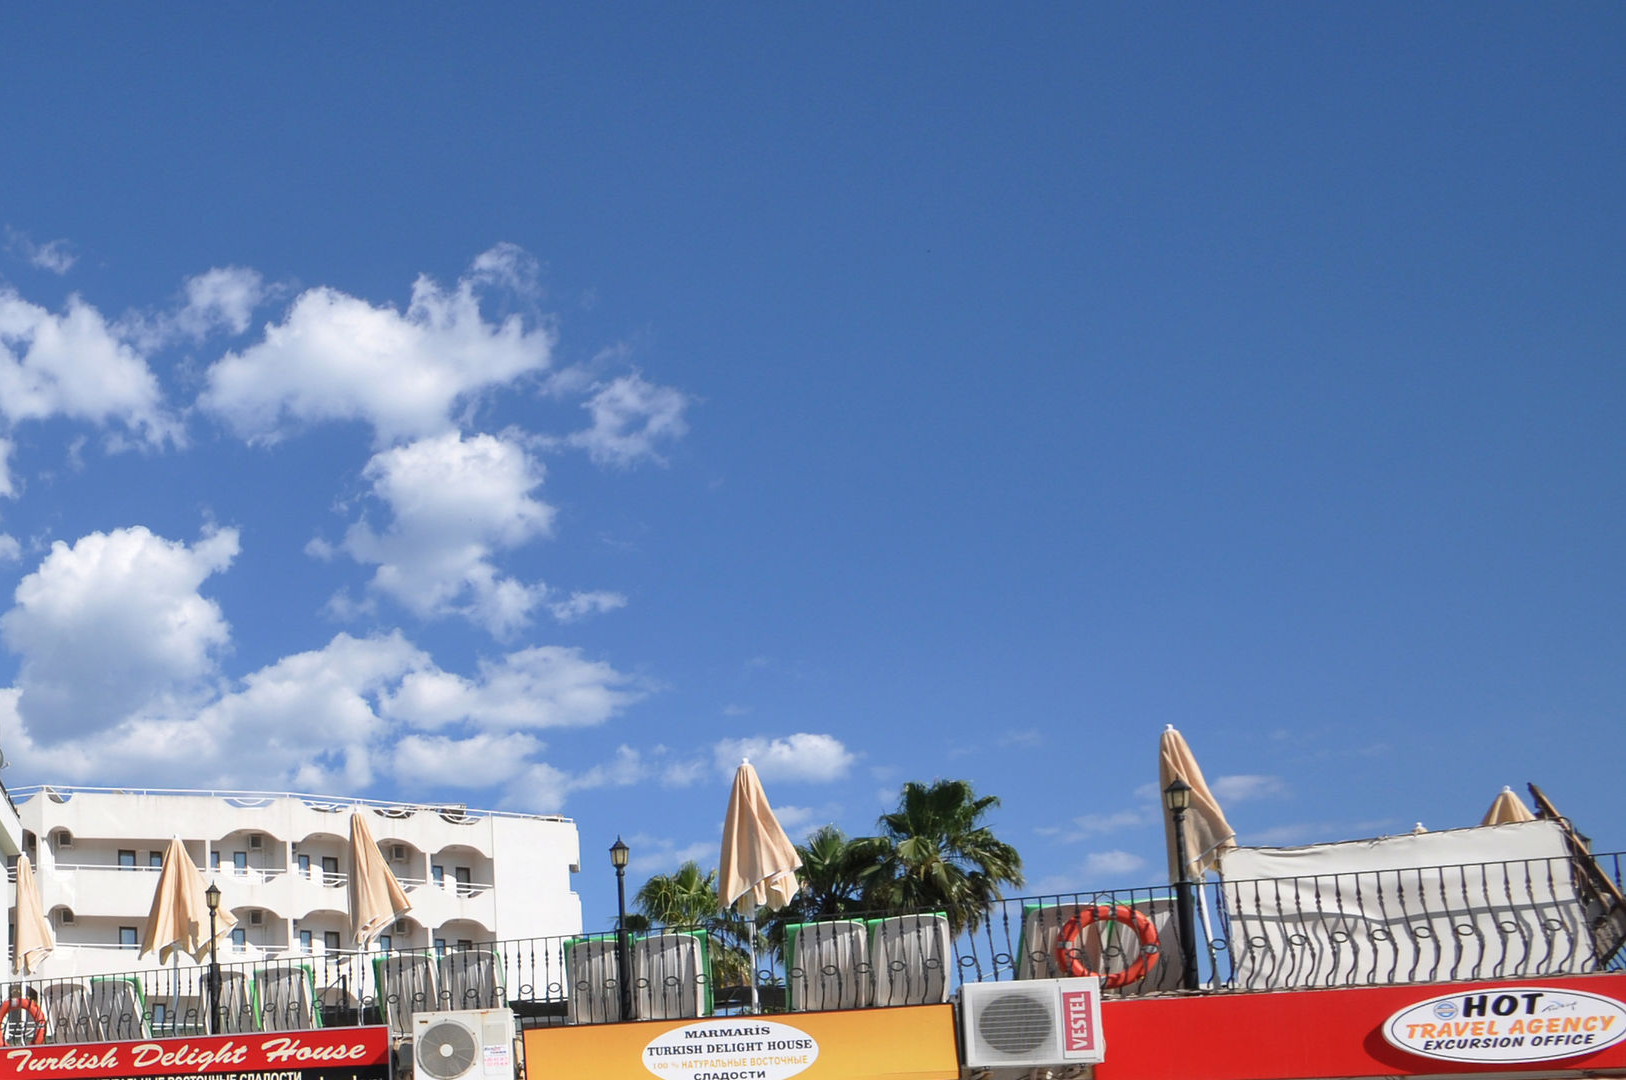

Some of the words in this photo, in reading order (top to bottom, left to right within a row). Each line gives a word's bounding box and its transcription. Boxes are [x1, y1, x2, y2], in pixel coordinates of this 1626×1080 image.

[1463, 993, 1544, 1018] HOT
[1069, 993, 1088, 1049] VESTEL
[1406, 1020, 1499, 1040] TRAVEL
[1509, 1015, 1616, 1035] AGENCY
[6, 1047, 119, 1072] Turkish
[131, 1041, 248, 1072] Delight
[261, 1037, 367, 1063] House
[647, 1045, 703, 1056] TURKISH
[706, 1042, 763, 1054] DELIGHT
[767, 1039, 813, 1050] HOUSE
[1423, 1036, 1525, 1051] EXCURSION
[1530, 1033, 1595, 1047] OFFICE
[681, 1058, 747, 1069] НАТУРАЛЬНЫЕ
[750, 1055, 809, 1066] ВОСТОЧНЫЕ
